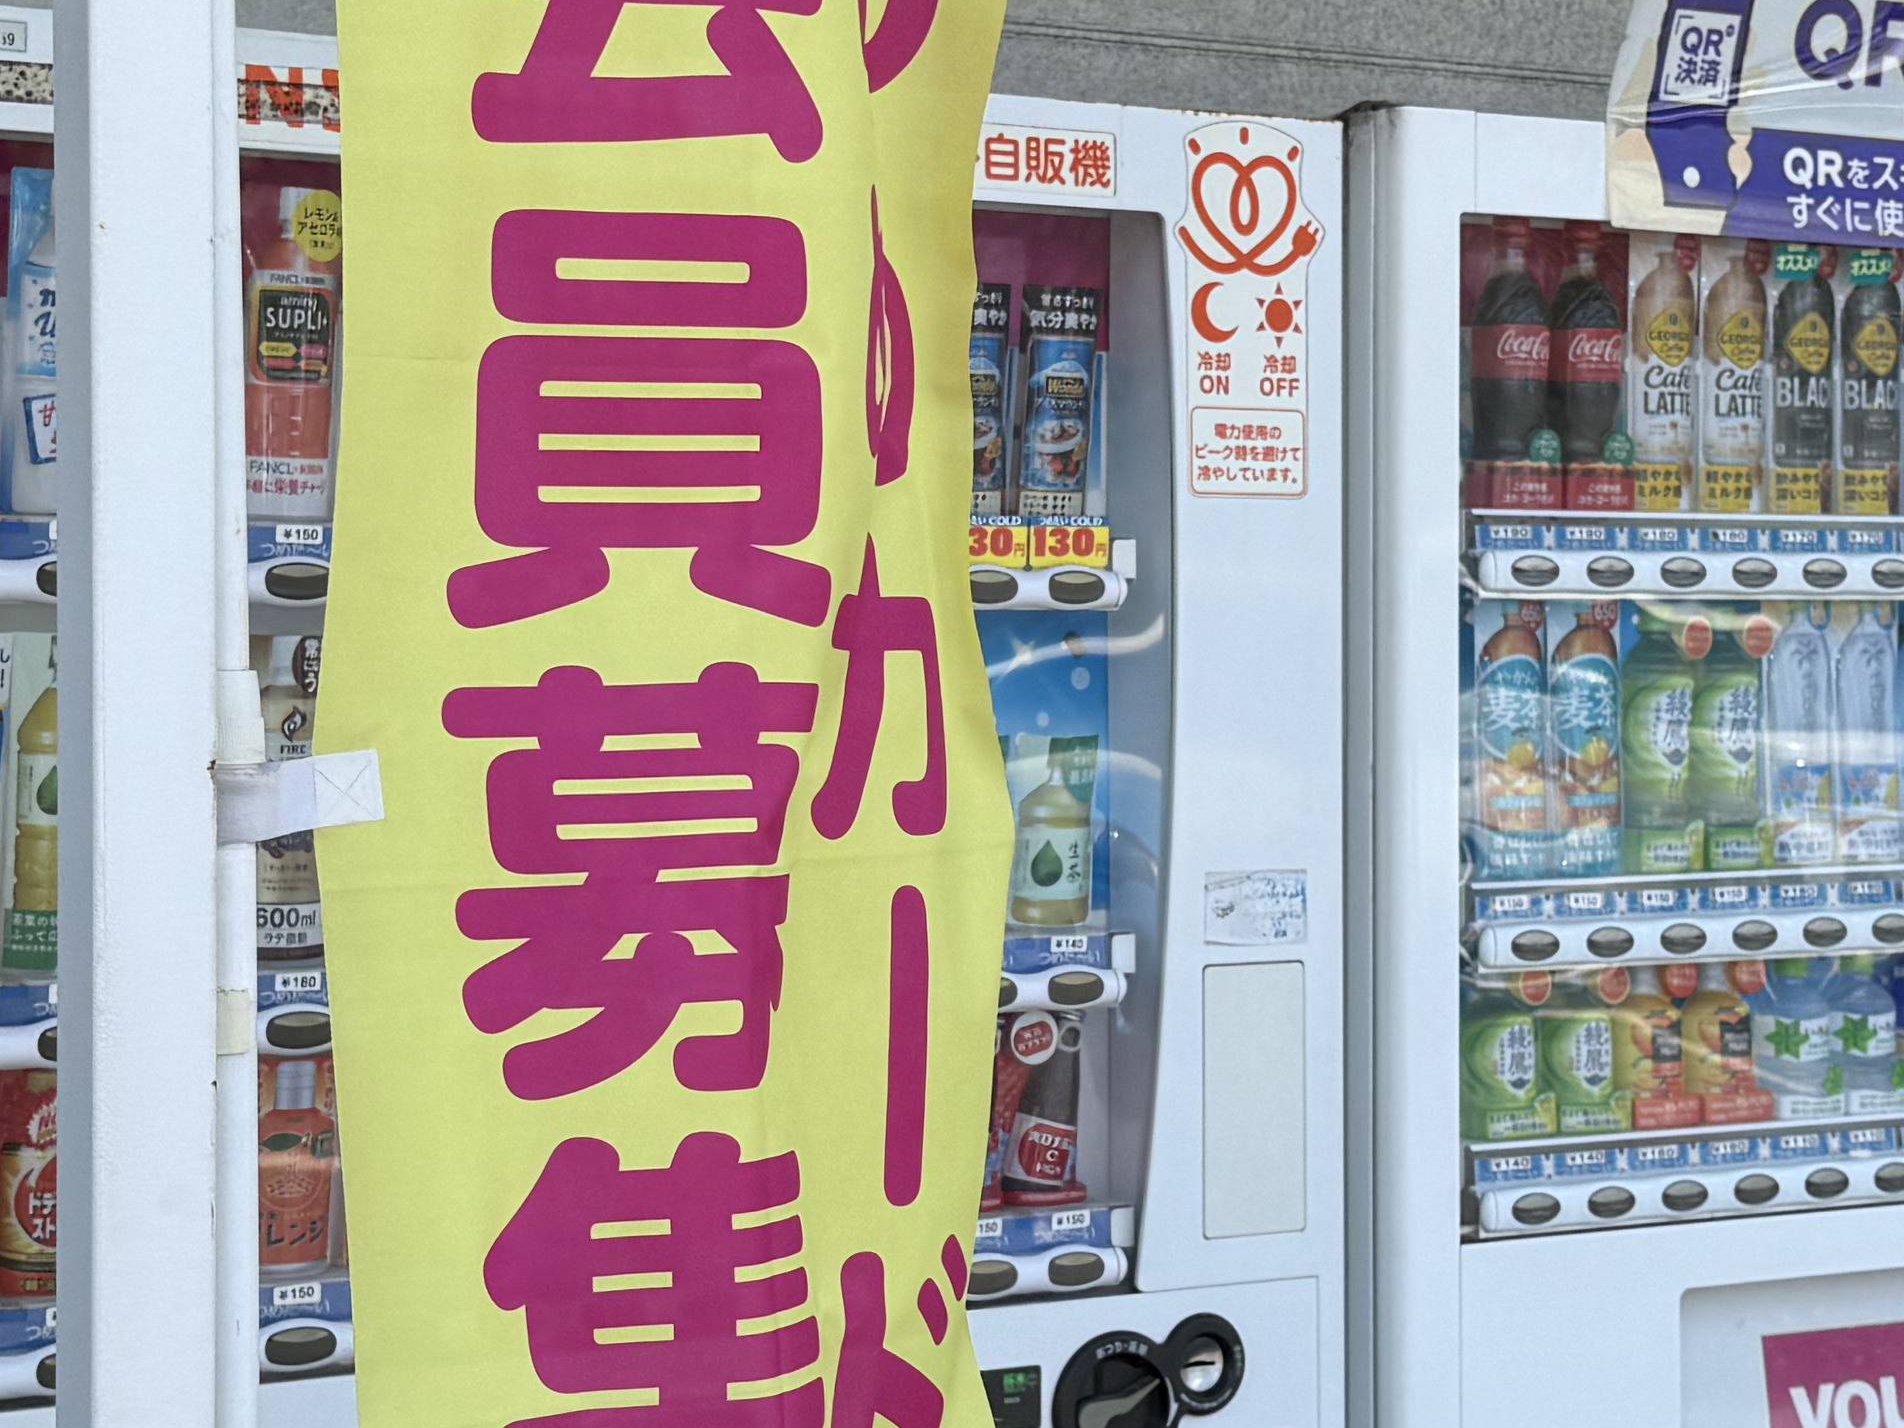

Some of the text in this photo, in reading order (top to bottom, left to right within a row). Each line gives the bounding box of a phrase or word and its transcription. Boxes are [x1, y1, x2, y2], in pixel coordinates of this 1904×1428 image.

[1681, 26, 1724, 57] QR
[1675, 56, 1721, 87] 決済
[1197, 351, 1231, 372] 冷却
[1263, 354, 1297, 374] 冷却
[1199, 374, 1230, 395] ON
[1259, 376, 1300, 397] OFF
